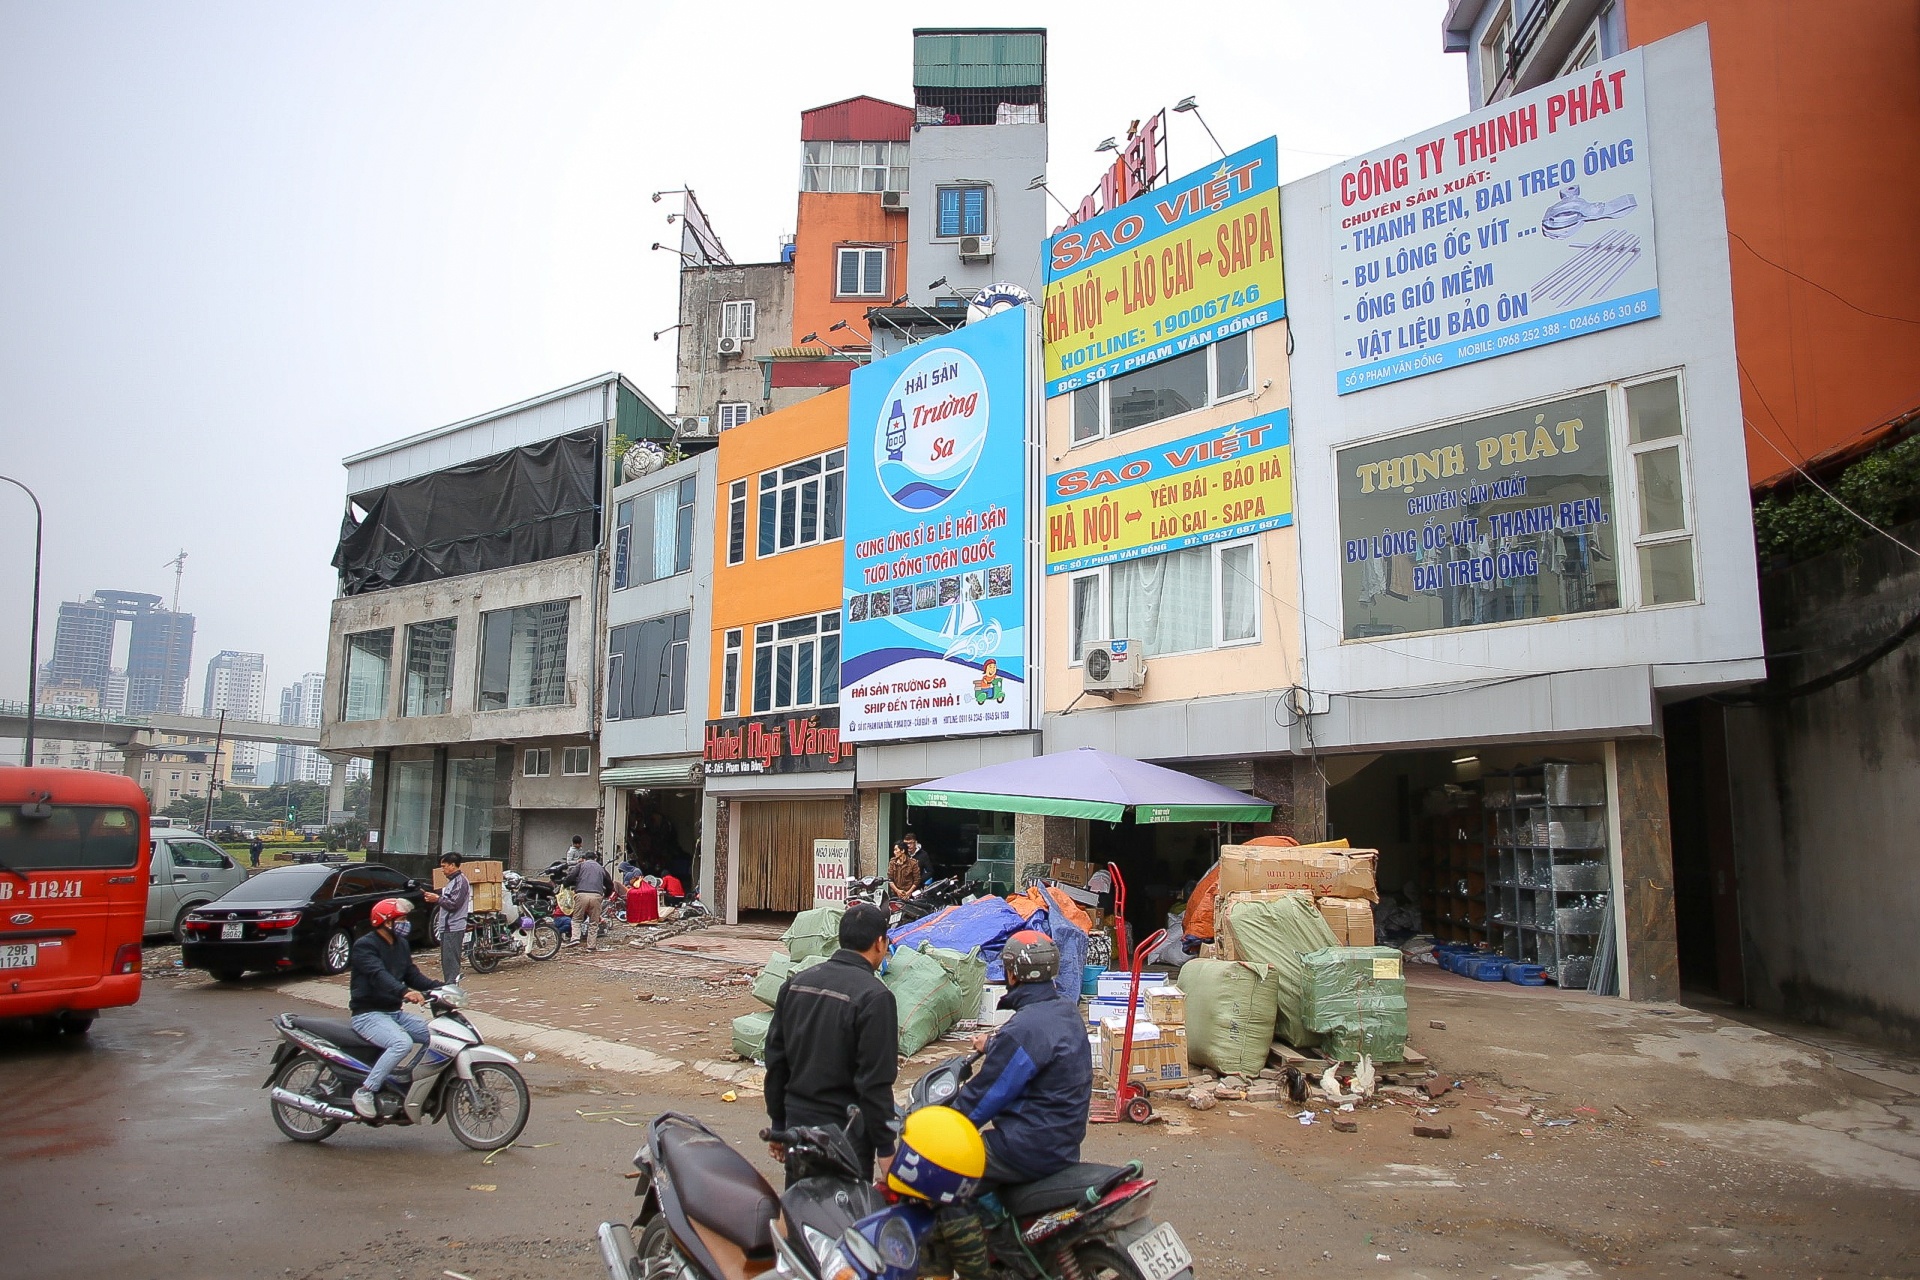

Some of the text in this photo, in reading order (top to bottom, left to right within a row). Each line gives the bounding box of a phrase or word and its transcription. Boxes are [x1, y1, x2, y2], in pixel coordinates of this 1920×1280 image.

[1341, 69, 1626, 206] CÔNG TY THỊNH PHÁT
[1051, 214, 1145, 273] SAO
[1155, 158, 1262, 213] VIỆT
[1342, 170, 1491, 229] CHUYÊN SẢN XUẤT:
[1353, 139, 1633, 251] THANH REN, ĐAI TREO ỐNG
[1047, 206, 1274, 343] HÀ NỘI LÀO CAI SAPA
[1355, 261, 1380, 287] BU
[1386, 243, 1437, 278] LÔNG
[1444, 227, 1471, 260] ỐC
[1478, 218, 1509, 249] VÍT
[1356, 261, 1494, 322] ỐNG GIÓ MỀM
[1061, 284, 1260, 371] HOTLINE: 19006746
[1345, 371, 1357, 387] SỐ
[1359, 372, 1364, 383] 9
[1366, 365, 1391, 382] PHẠM
[1392, 359, 1412, 375] VĂN
[1458, 339, 1495, 358] MOBILE:
[1497, 332, 1519, 348] 0968
[1523, 327, 1540, 342] 252
[1542, 322, 1560, 337] 388
[1569, 312, 1600, 330] 02466
[1603, 309, 1616, 321] 86
[1619, 304, 1631, 317] 30
[1634, 300, 1647, 313] 68
[1357, 293, 1528, 360] VẬT LIỆU BẢO ÔN
[905, 362, 958, 396] HẢI SẢN
[1057, 376, 1082, 393] ĐC:
[1086, 364, 1107, 382] SỐ
[1111, 364, 1119, 375] 7
[1177, 331, 1212, 356] VĂN
[912, 391, 978, 430] Trường
[931, 436, 954, 462] Sa
[1056, 424, 1272, 497] SAO VIỆT
[1356, 413, 1583, 494] THỊNH PHÁT
[1150, 454, 1281, 508] YÊN BÁI BẢO HÀ
[1407, 487, 1457, 516] CHUYÊN
[1492, 470, 1527, 498] XUẤT
[856, 538, 884, 559] CUNG
[888, 530, 910, 552] ỨNG
[926, 525, 934, 543] &
[938, 516, 952, 541] LẺ
[956, 510, 978, 539] HẢI
[981, 504, 1006, 531] SẢN
[1050, 496, 1119, 552] HÀ NỘI
[1070, 557, 1083, 569] SỐ
[1085, 558, 1089, 567] 7
[1202, 529, 1233, 543] 02437
[1236, 523, 1255, 535] 687
[1259, 518, 1280, 530] 687
[1151, 496, 1265, 540] LÀO CAI SAPA
[1346, 497, 1610, 563] BU LÔNG ỐC VÍT, THANH REN,
[864, 535, 996, 585] TƯƠI SỐNG TOÀN QUỐC
[1413, 543, 1538, 591] ĐAI TREO ỐNG
[851, 678, 946, 698] HẢI SẢN TRƯỜNG SA
[864, 702, 886, 714] SHIP
[887, 696, 907, 711] ĐẾN
[910, 696, 929, 711] TẬN
[704, 714, 840, 768] Hotel Ngõ Vắng
[0, 880, 82, 899] B 112.41
[818, 859, 845, 880] NHÀ
[7, 945, 28, 956] 29B
[1148, 1247, 1184, 1279] 6554
